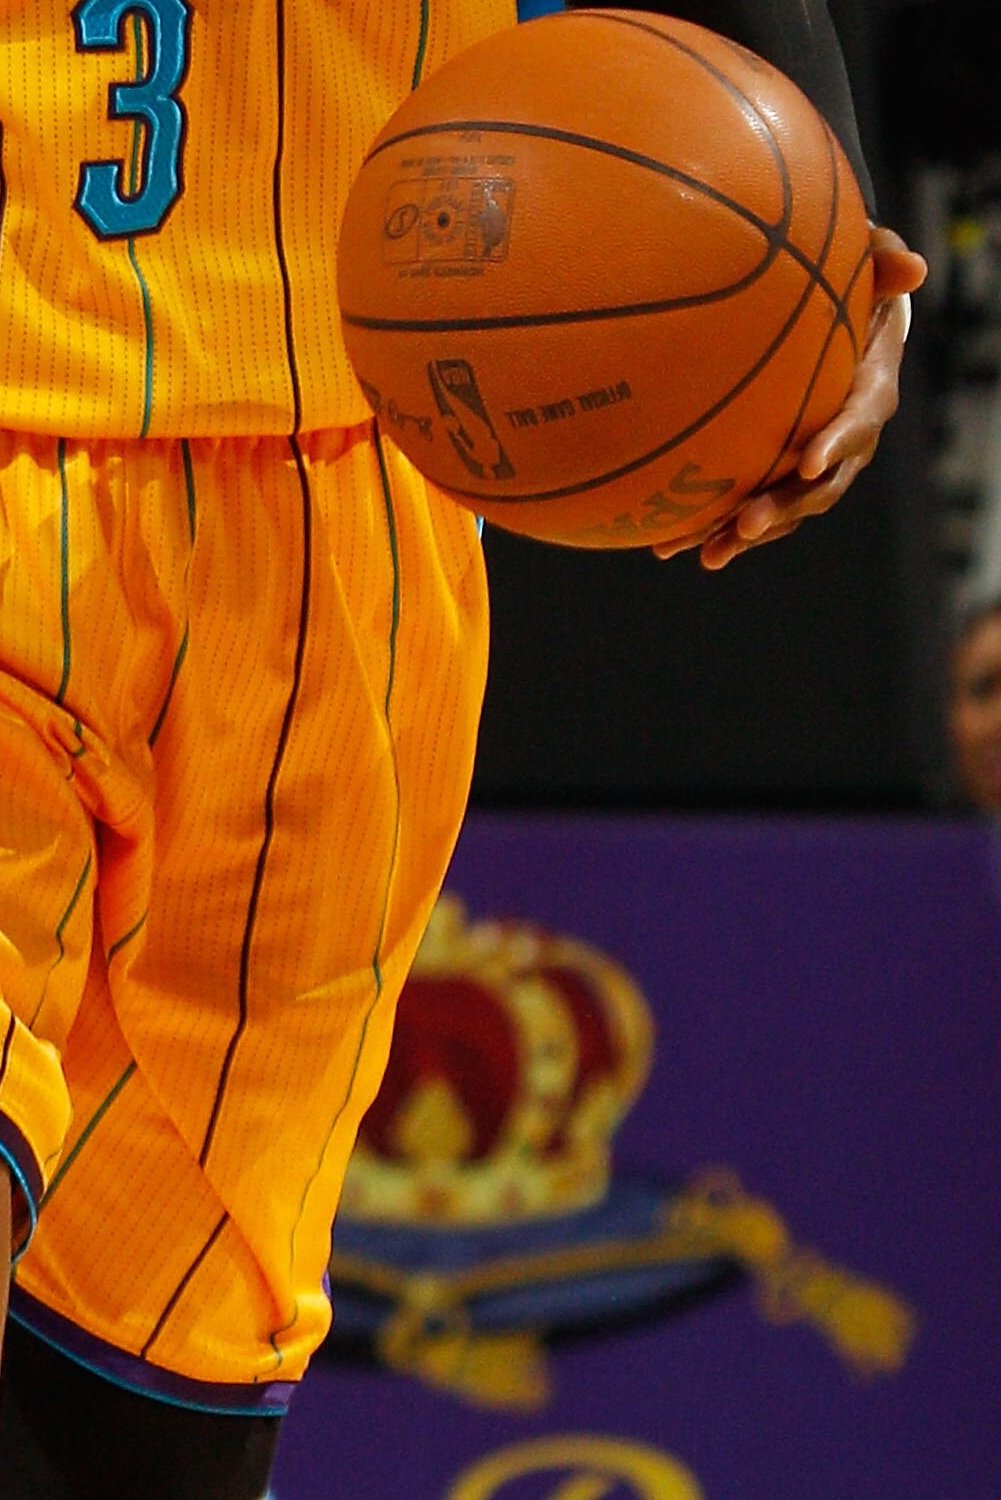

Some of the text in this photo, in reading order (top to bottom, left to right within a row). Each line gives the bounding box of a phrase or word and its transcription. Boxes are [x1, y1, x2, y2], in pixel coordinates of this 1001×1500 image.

[505, 380, 632, 429] OFFICIAL GAME BALL
